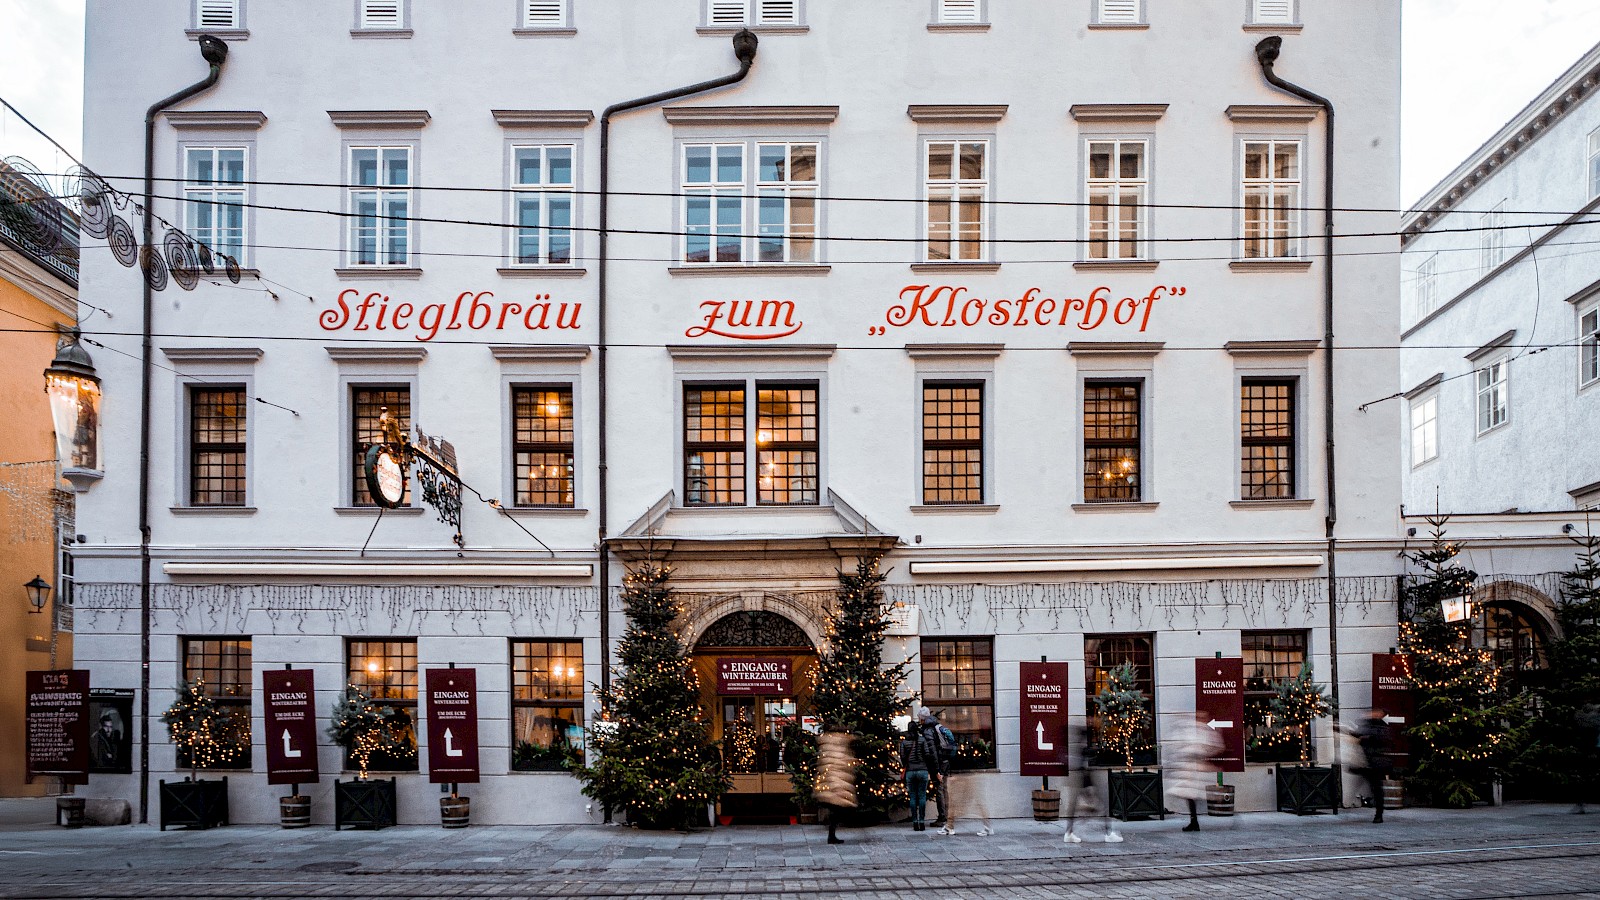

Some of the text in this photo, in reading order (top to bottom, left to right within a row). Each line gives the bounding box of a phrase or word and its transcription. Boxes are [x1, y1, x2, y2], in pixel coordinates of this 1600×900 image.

[319, 288, 582, 342] Stieglbräu
[731, 663, 778, 671] EINGANG
[722, 672, 787, 680] WINTERZAUBER
[1203, 681, 1236, 689] EINGANG
[271, 692, 307, 700] EINGANG
